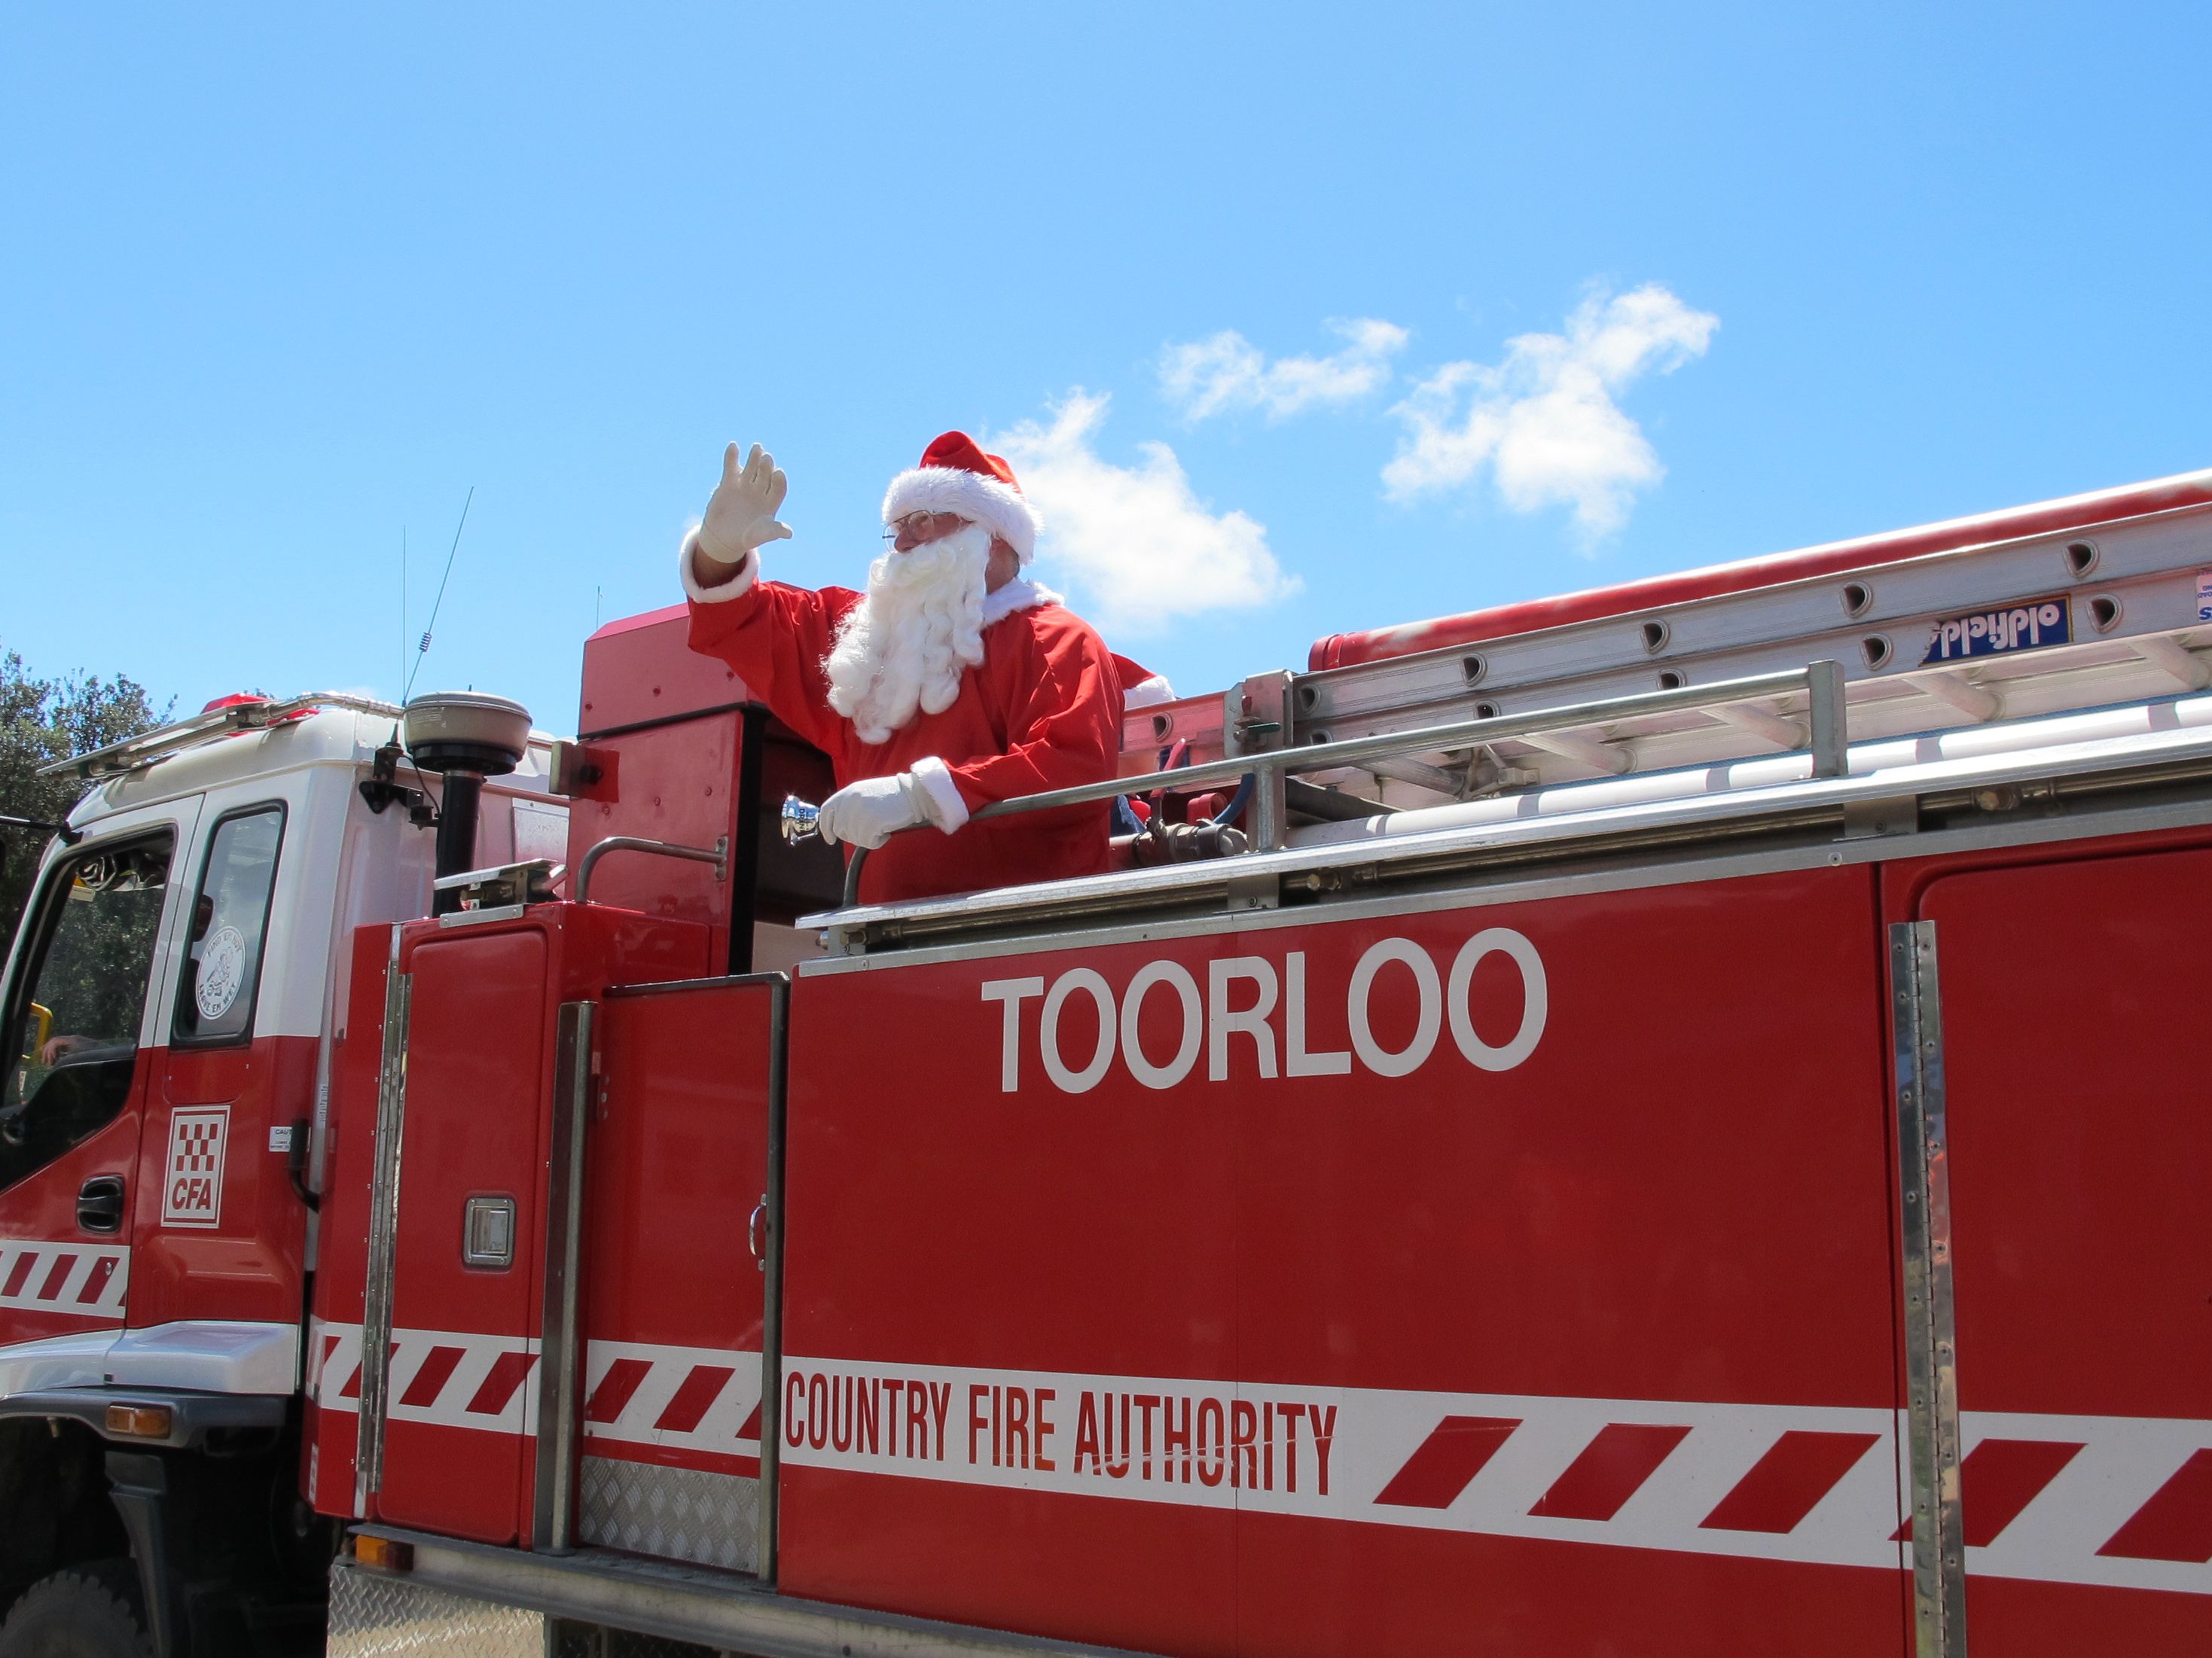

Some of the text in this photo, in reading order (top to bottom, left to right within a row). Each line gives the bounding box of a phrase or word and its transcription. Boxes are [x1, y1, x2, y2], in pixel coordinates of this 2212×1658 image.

[981, 927, 1548, 1093] TOORLOO
[172, 1178, 212, 1210] CFA
[785, 1371, 1338, 1495] COUNTRY FIRE AUTHORITY
